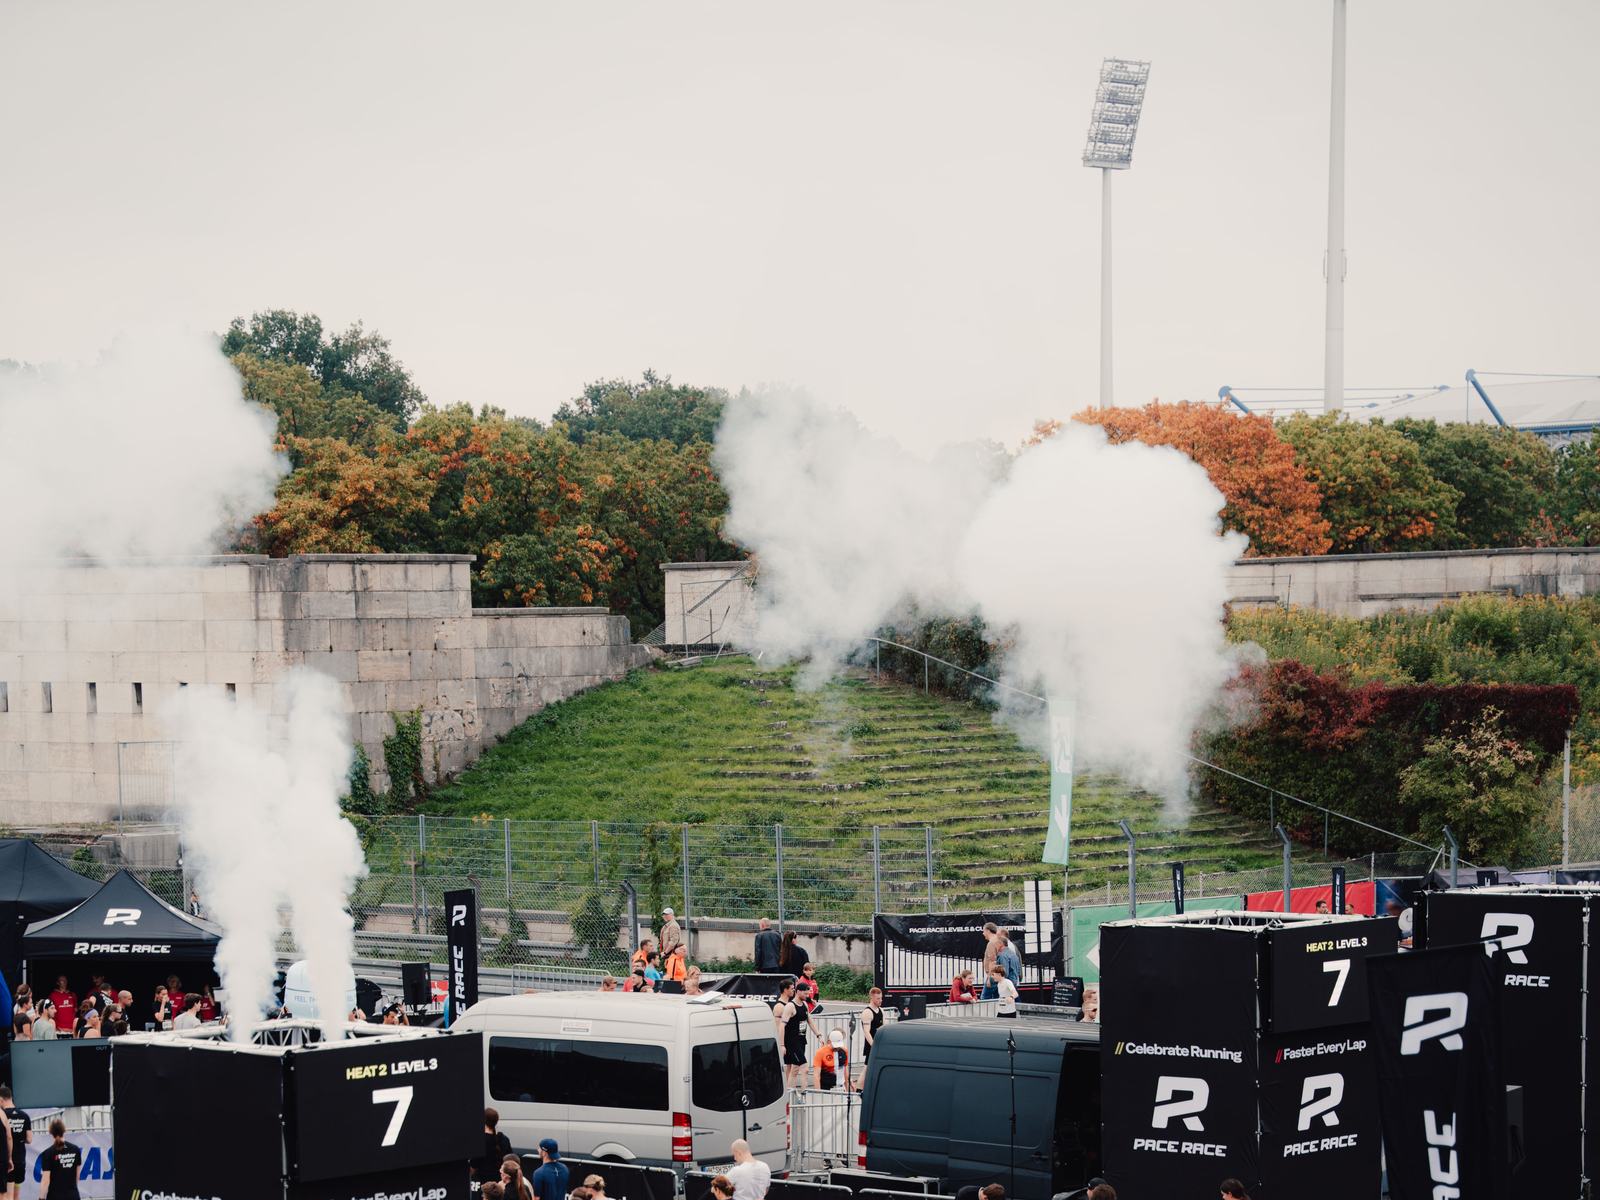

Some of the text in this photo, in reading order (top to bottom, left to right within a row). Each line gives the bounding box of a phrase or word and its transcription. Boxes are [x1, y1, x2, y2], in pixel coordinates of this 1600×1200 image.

[90, 944, 130, 954] PACE
[131, 944, 171, 954] RACE
[1306, 937, 1368, 952] HEAT 2 LEVEL 3
[1323, 958, 1351, 1007] 7
[1504, 974, 1550, 988] RACE
[1125, 1042, 1189, 1057] Celebrate
[1191, 1046, 1242, 1063] Running
[1283, 1046, 1316, 1061] Faster
[1317, 1042, 1347, 1055] Every
[1347, 1039, 1367, 1052] Lap
[346, 1058, 438, 1080] HEAT 2 LEVEL 3
[372, 1086, 413, 1147] 7
[1133, 1138, 1227, 1157] PACE RACE
[1284, 1134, 1358, 1157] PACE RACE
